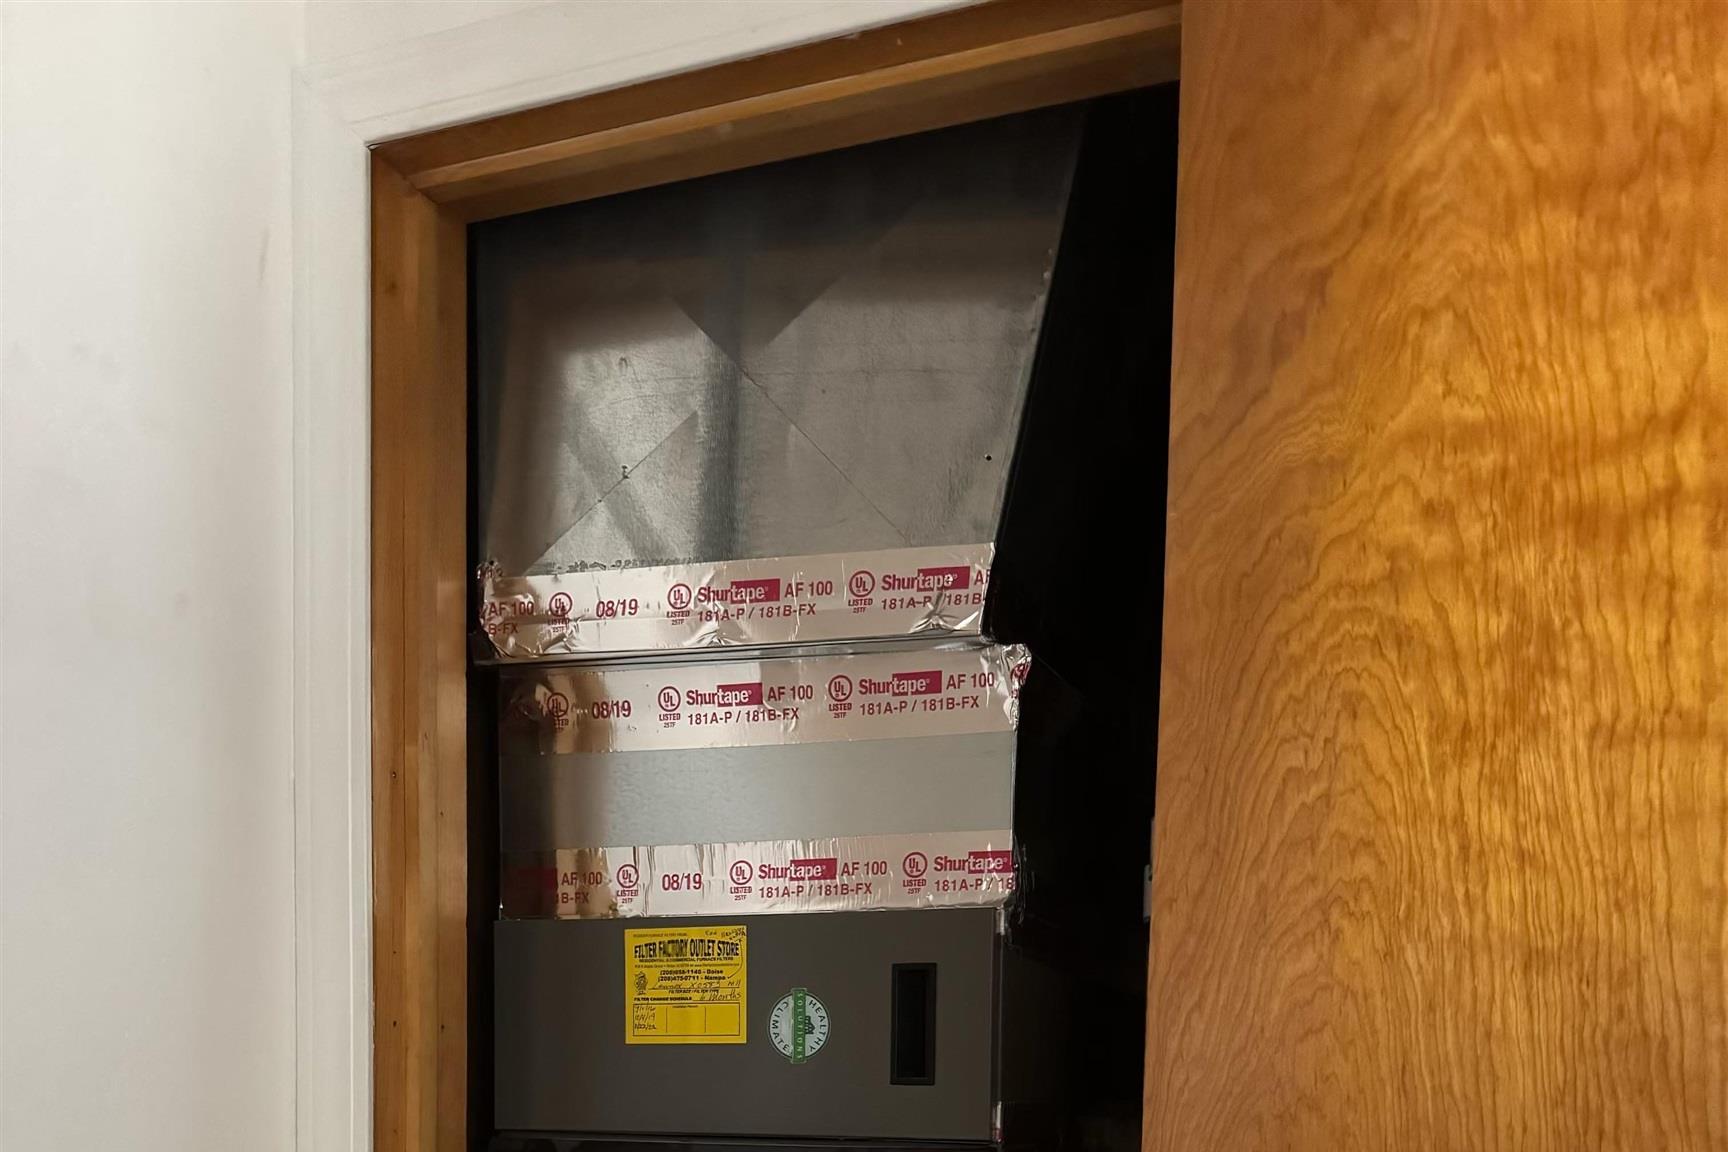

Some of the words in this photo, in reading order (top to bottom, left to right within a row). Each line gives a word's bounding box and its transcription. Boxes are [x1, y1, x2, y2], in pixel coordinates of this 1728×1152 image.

[881, 572, 953, 591] Shurtape
[697, 584, 765, 603] Shurtape
[784, 582, 804, 598] AF
[808, 580, 833, 597] 100
[511, 601, 534, 615] 100
[596, 598, 638, 619] 08/19
[848, 598, 873, 607] LISTED
[881, 595, 932, 610] 181A-P
[667, 610, 690, 619] LISTED
[698, 609, 745, 623] 181A-P
[759, 602, 816, 619] 181B-FX
[858, 677, 927, 697] Shurtape
[946, 673, 966, 690] AF
[971, 672, 995, 688] 100
[686, 687, 749, 706] Shurtape
[767, 686, 785, 701] AF
[789, 684, 813, 700] 100
[592, 700, 632, 720] 08/19
[688, 710, 732, 725] 181A-P
[745, 706, 799, 723] 181B-FX
[828, 702, 852, 711] LISTED
[860, 701, 907, 716] 181A-P
[922, 696, 980, 711] 181B-FX
[659, 713, 681, 722] LISTED
[758, 862, 824, 881] Shurtape
[841, 861, 861, 876] AF
[864, 859, 888, 875] 100
[934, 854, 1003, 872] Shurtape
[561, 871, 577, 886] AF
[582, 871, 603, 885] 100
[661, 872, 702, 892] 08/19
[902, 878, 927, 888] LISTED
[934, 877, 983, 892] 181A-P
[616, 889, 639, 897] LISTED
[729, 885, 753, 894] LISTED
[759, 884, 804, 899] 181A-P
[817, 882, 873, 897] 181B-FX
[634, 942, 657, 959] FILTER
[658, 939, 689, 958] FACTORY
[689, 938, 716, 957] OUTLET
[717, 939, 740, 957] STORE
[771, 1001, 790, 1052] CLIMATE
[808, 999, 827, 1052] HEALTHY
